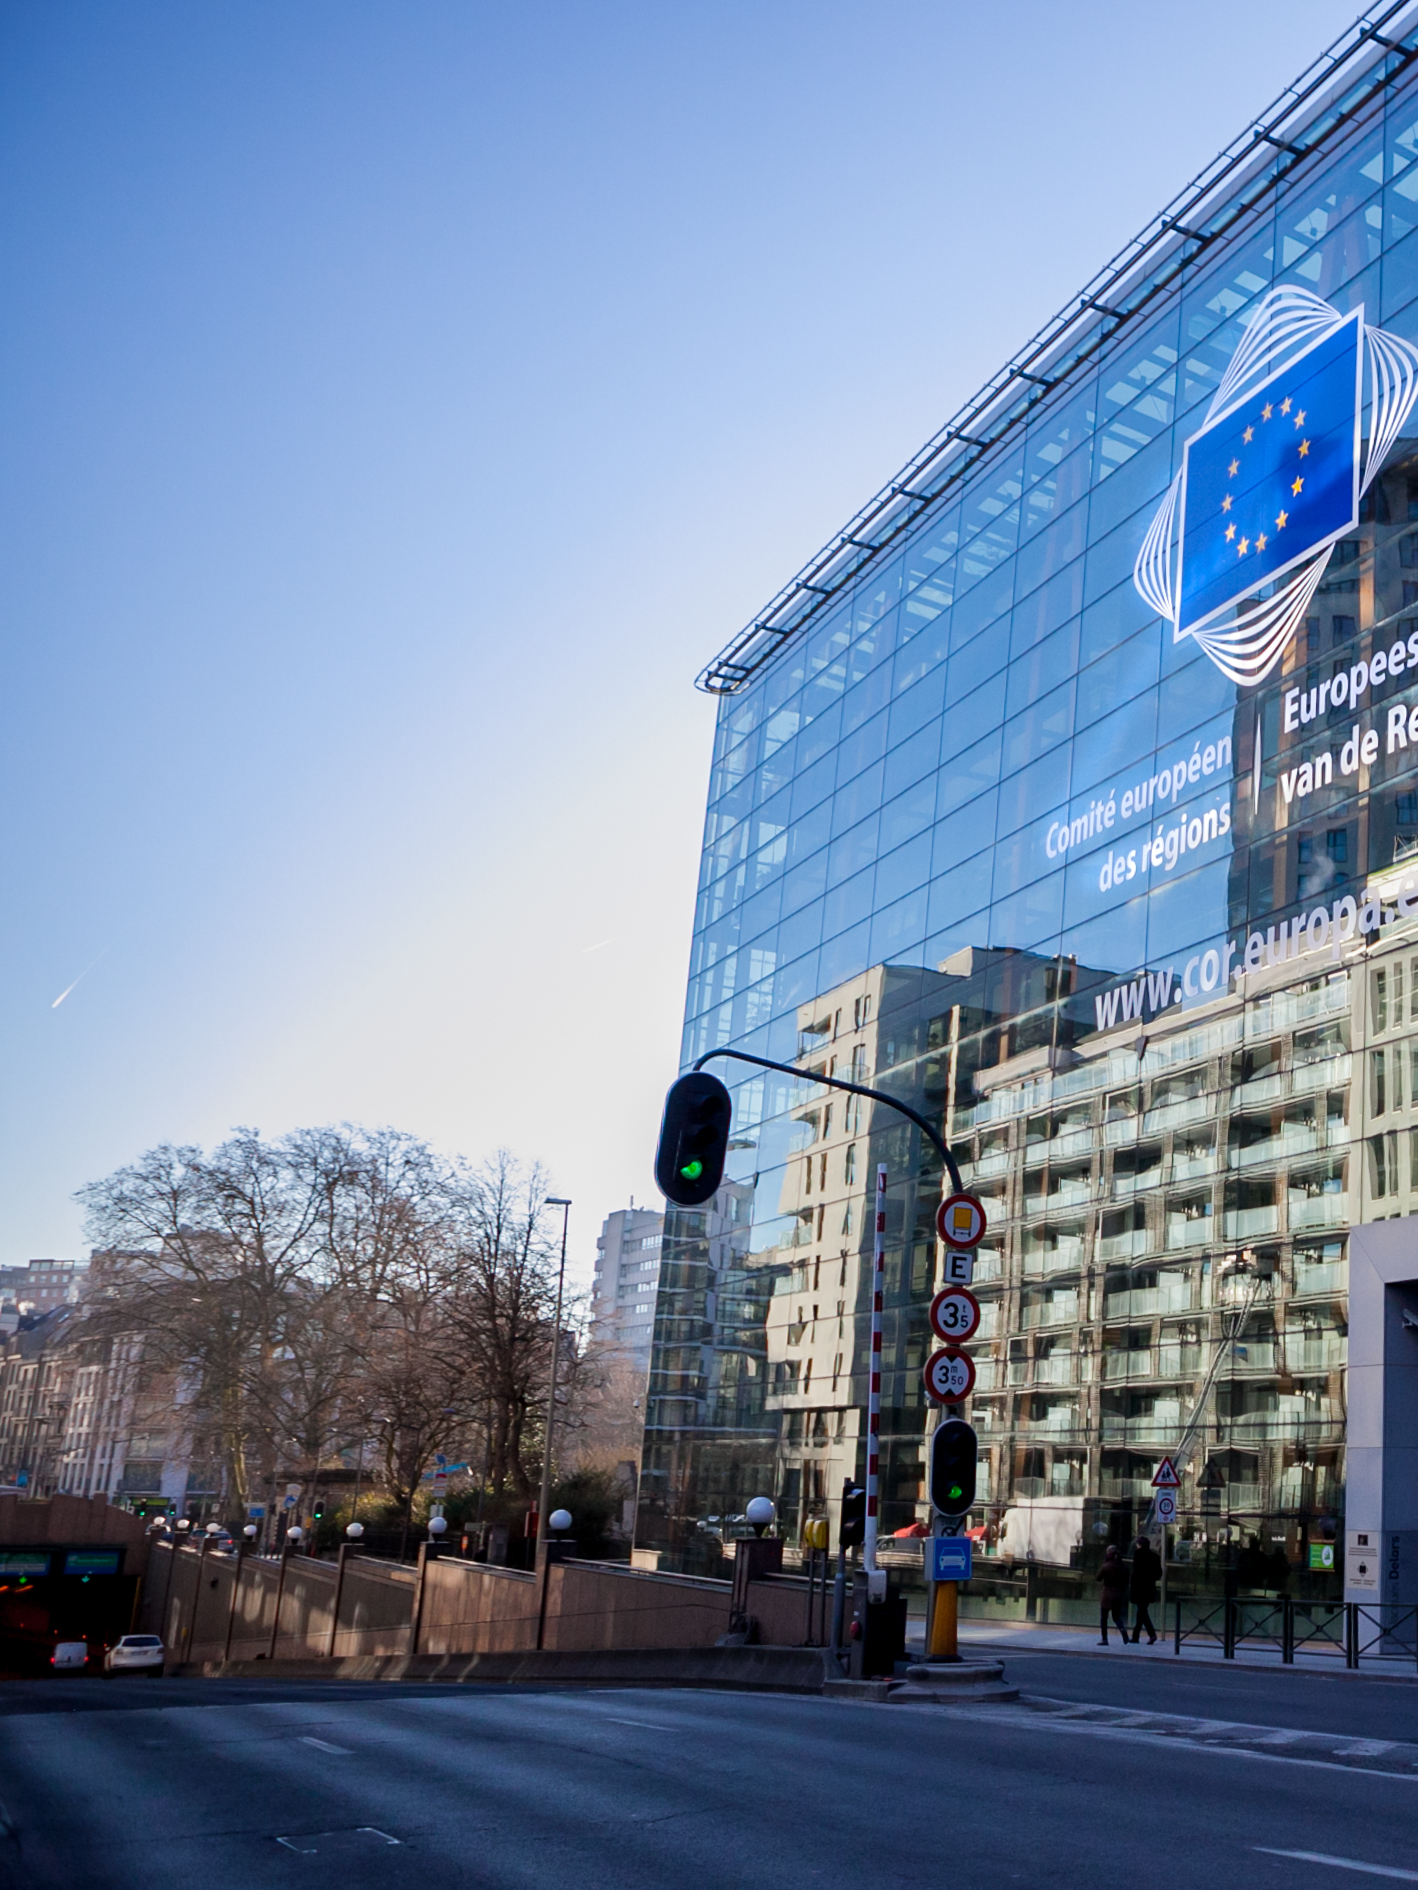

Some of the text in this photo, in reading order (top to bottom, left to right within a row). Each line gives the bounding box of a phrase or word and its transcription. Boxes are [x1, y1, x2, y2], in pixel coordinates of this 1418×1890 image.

[1045, 735, 1232, 859] Comité européen
[1280, 750, 1333, 804] van
[1340, 724, 1379, 776] de
[1099, 802, 1231, 893] des régions
[951, 1256, 967, 1279] E
[1388, 1536, 1400, 1580] Delors
